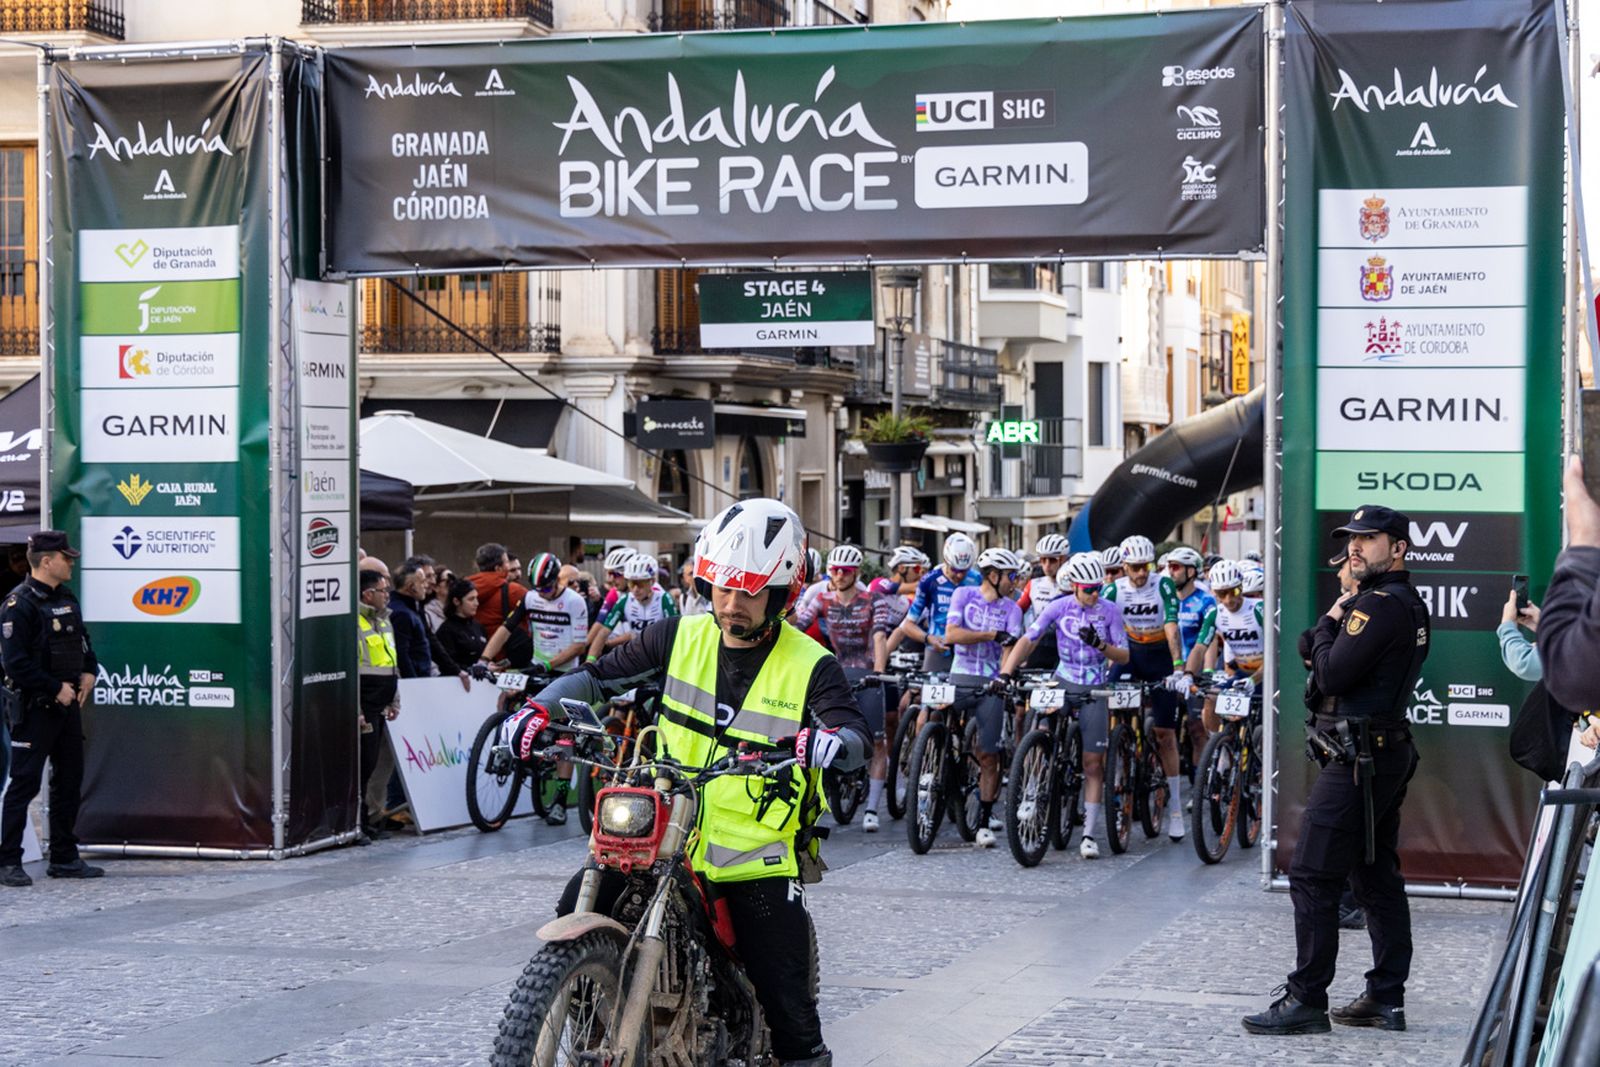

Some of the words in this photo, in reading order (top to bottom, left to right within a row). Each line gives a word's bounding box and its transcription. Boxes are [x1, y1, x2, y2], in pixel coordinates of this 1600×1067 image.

[1185, 66, 1235, 80] esedos
[364, 71, 462, 100] Andalucía
[1330, 64, 1518, 113] Andalucía
[552, 65, 897, 158] Andalucía
[929, 99, 987, 124] UCI
[1002, 98, 1046, 119] SHC
[87, 118, 234, 162] Andalucía
[1176, 130, 1221, 140] CICLISMO
[391, 130, 490, 157] GRANADA
[413, 158, 468, 189] JAÉN
[935, 163, 1069, 188] GARMIN
[559, 158, 700, 218] BIKE
[719, 152, 899, 214] RACE
[900, 155, 915, 164] BY
[393, 191, 490, 221] CÓRDOBA
[152, 246, 213, 260] Diputación
[153, 260, 168, 270] de
[170, 257, 216, 269] Granada
[1401, 272, 1486, 282] AYUNTAMIENTO
[743, 280, 807, 296] STAGE
[811, 280, 826, 294] 4
[1400, 286, 1415, 294] DE
[1418, 283, 1447, 294] JAÉN
[150, 304, 197, 314] DIPUTACIÓN
[760, 299, 812, 318] JAÉN
[150, 316, 161, 324] DE
[162, 314, 182, 323] JAÉN
[756, 329, 818, 340] GARMIN
[1404, 322, 1485, 336] AYUNTAMIENTO
[1404, 341, 1417, 354] DE
[1420, 340, 1469, 354] CORDOBA
[156, 351, 214, 364] Diputación
[1234, 319, 1247, 391] AMATE
[156, 366, 170, 376] de
[172, 364, 214, 376] Córdoba
[1339, 398, 1501, 422] GARMIN
[102, 414, 228, 437] GARMIN
[986, 420, 1039, 442] ABR
[1131, 462, 1197, 489] garmin.com
[156, 483, 182, 494] CAJA
[184, 482, 217, 494] RURAL
[175, 494, 201, 507] JAÉN
[146, 530, 216, 542] SCIENTIFFIC
[1123, 603, 1159, 616] KTM
[1223, 628, 1259, 641] KTM
[95, 663, 185, 689] Andalucía
[193, 671, 209, 680] UCI
[504, 674, 522, 687] 13-2
[94, 688, 134, 705] BIKE
[138, 689, 185, 706] RACE
[930, 687, 946, 700] 2-1
[1453, 684, 1473, 696] UCI
[194, 693, 231, 702] GARMIN
[762, 697, 778, 708] BIKE
[778, 700, 799, 710] RACE
[1040, 691, 1056, 704] 2-2
[1117, 692, 1131, 708] 3-1
[1226, 698, 1241, 712] 3-2
[1455, 710, 1503, 719] GARMIN
[520, 716, 543, 760] HONDA
